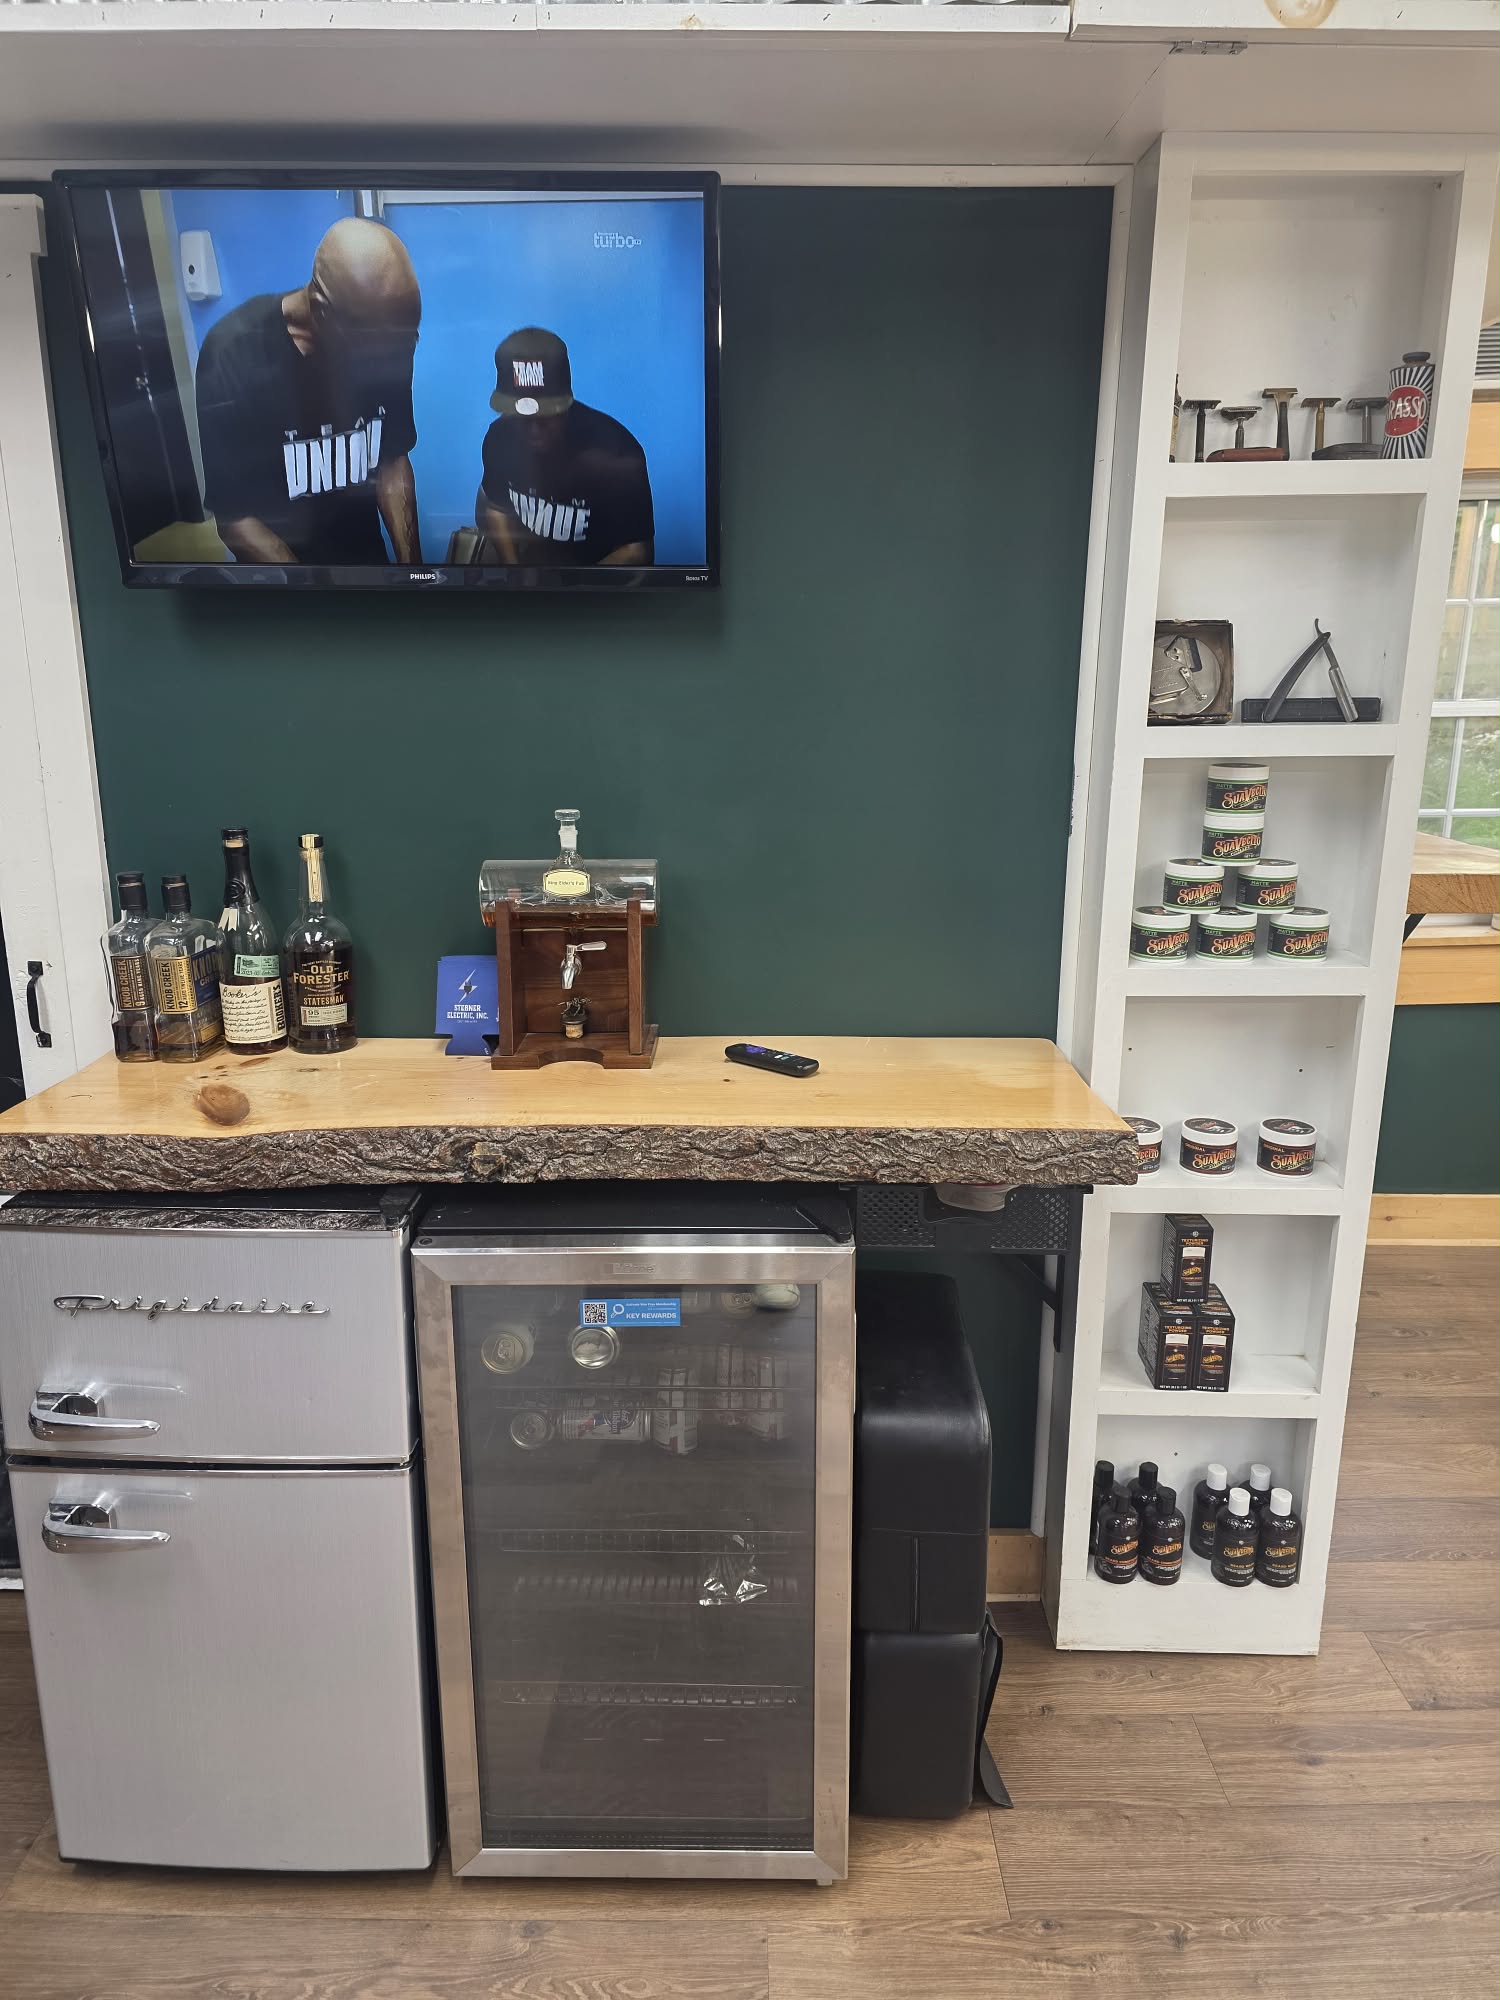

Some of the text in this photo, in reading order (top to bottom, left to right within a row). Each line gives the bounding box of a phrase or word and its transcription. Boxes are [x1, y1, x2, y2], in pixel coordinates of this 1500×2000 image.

[593, 231, 635, 248] turbo
[1386, 396, 1427, 421] RASSO
[293, 971, 349, 984] FORESTER
[311, 965, 334, 974] OLD
[117, 959, 132, 1008] KNOB CREEK
[161, 962, 175, 1010] KNOB CREEK
[178, 1000, 188, 1009] 12
[273, 985, 285, 1031] BOOKER'S
[303, 995, 344, 1006] STATESMAN
[54, 1294, 331, 1321] Frigidaire
